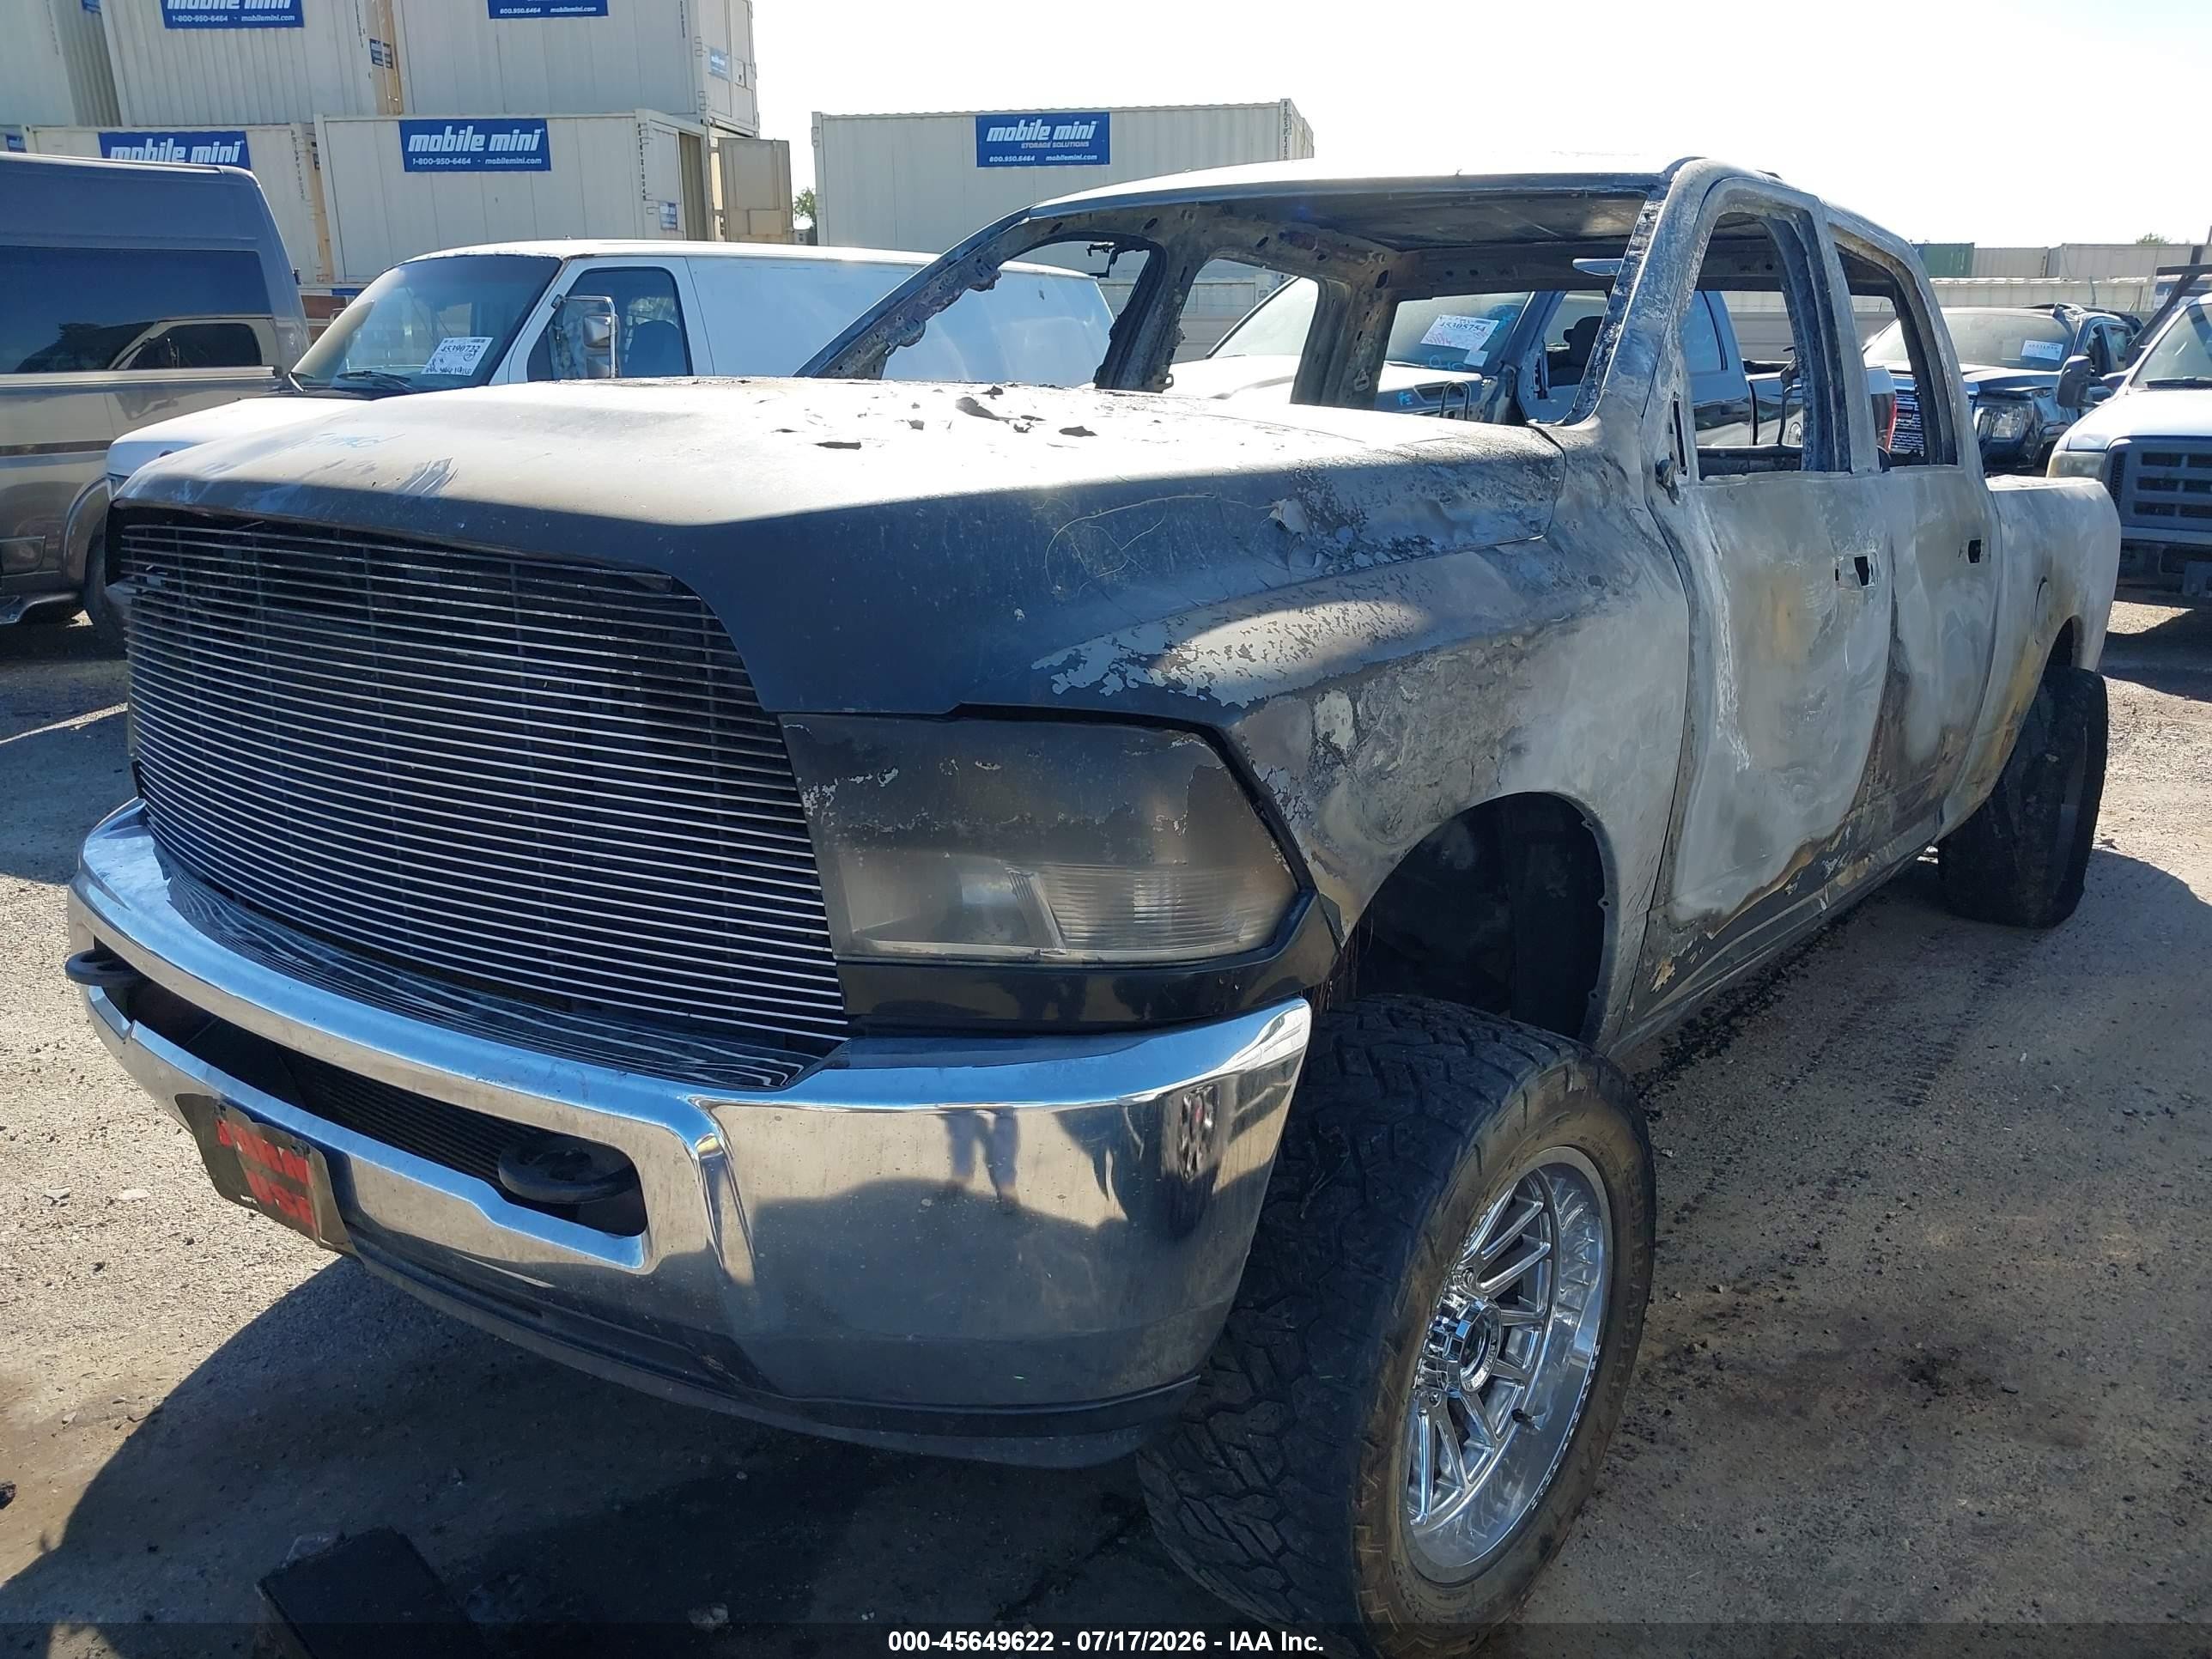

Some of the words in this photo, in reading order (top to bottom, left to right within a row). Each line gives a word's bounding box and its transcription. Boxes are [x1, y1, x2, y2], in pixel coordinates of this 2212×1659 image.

[408, 125, 486, 152] mobile
[489, 129, 542, 152] mini
[987, 118, 1051, 142] mobile
[1053, 120, 1097, 140] mini
[110, 138, 186, 162] mobile
[190, 141, 241, 163] mini
[412, 157, 471, 166] 1-800-950-6464
[484, 156, 542, 165] mobilemini.com
